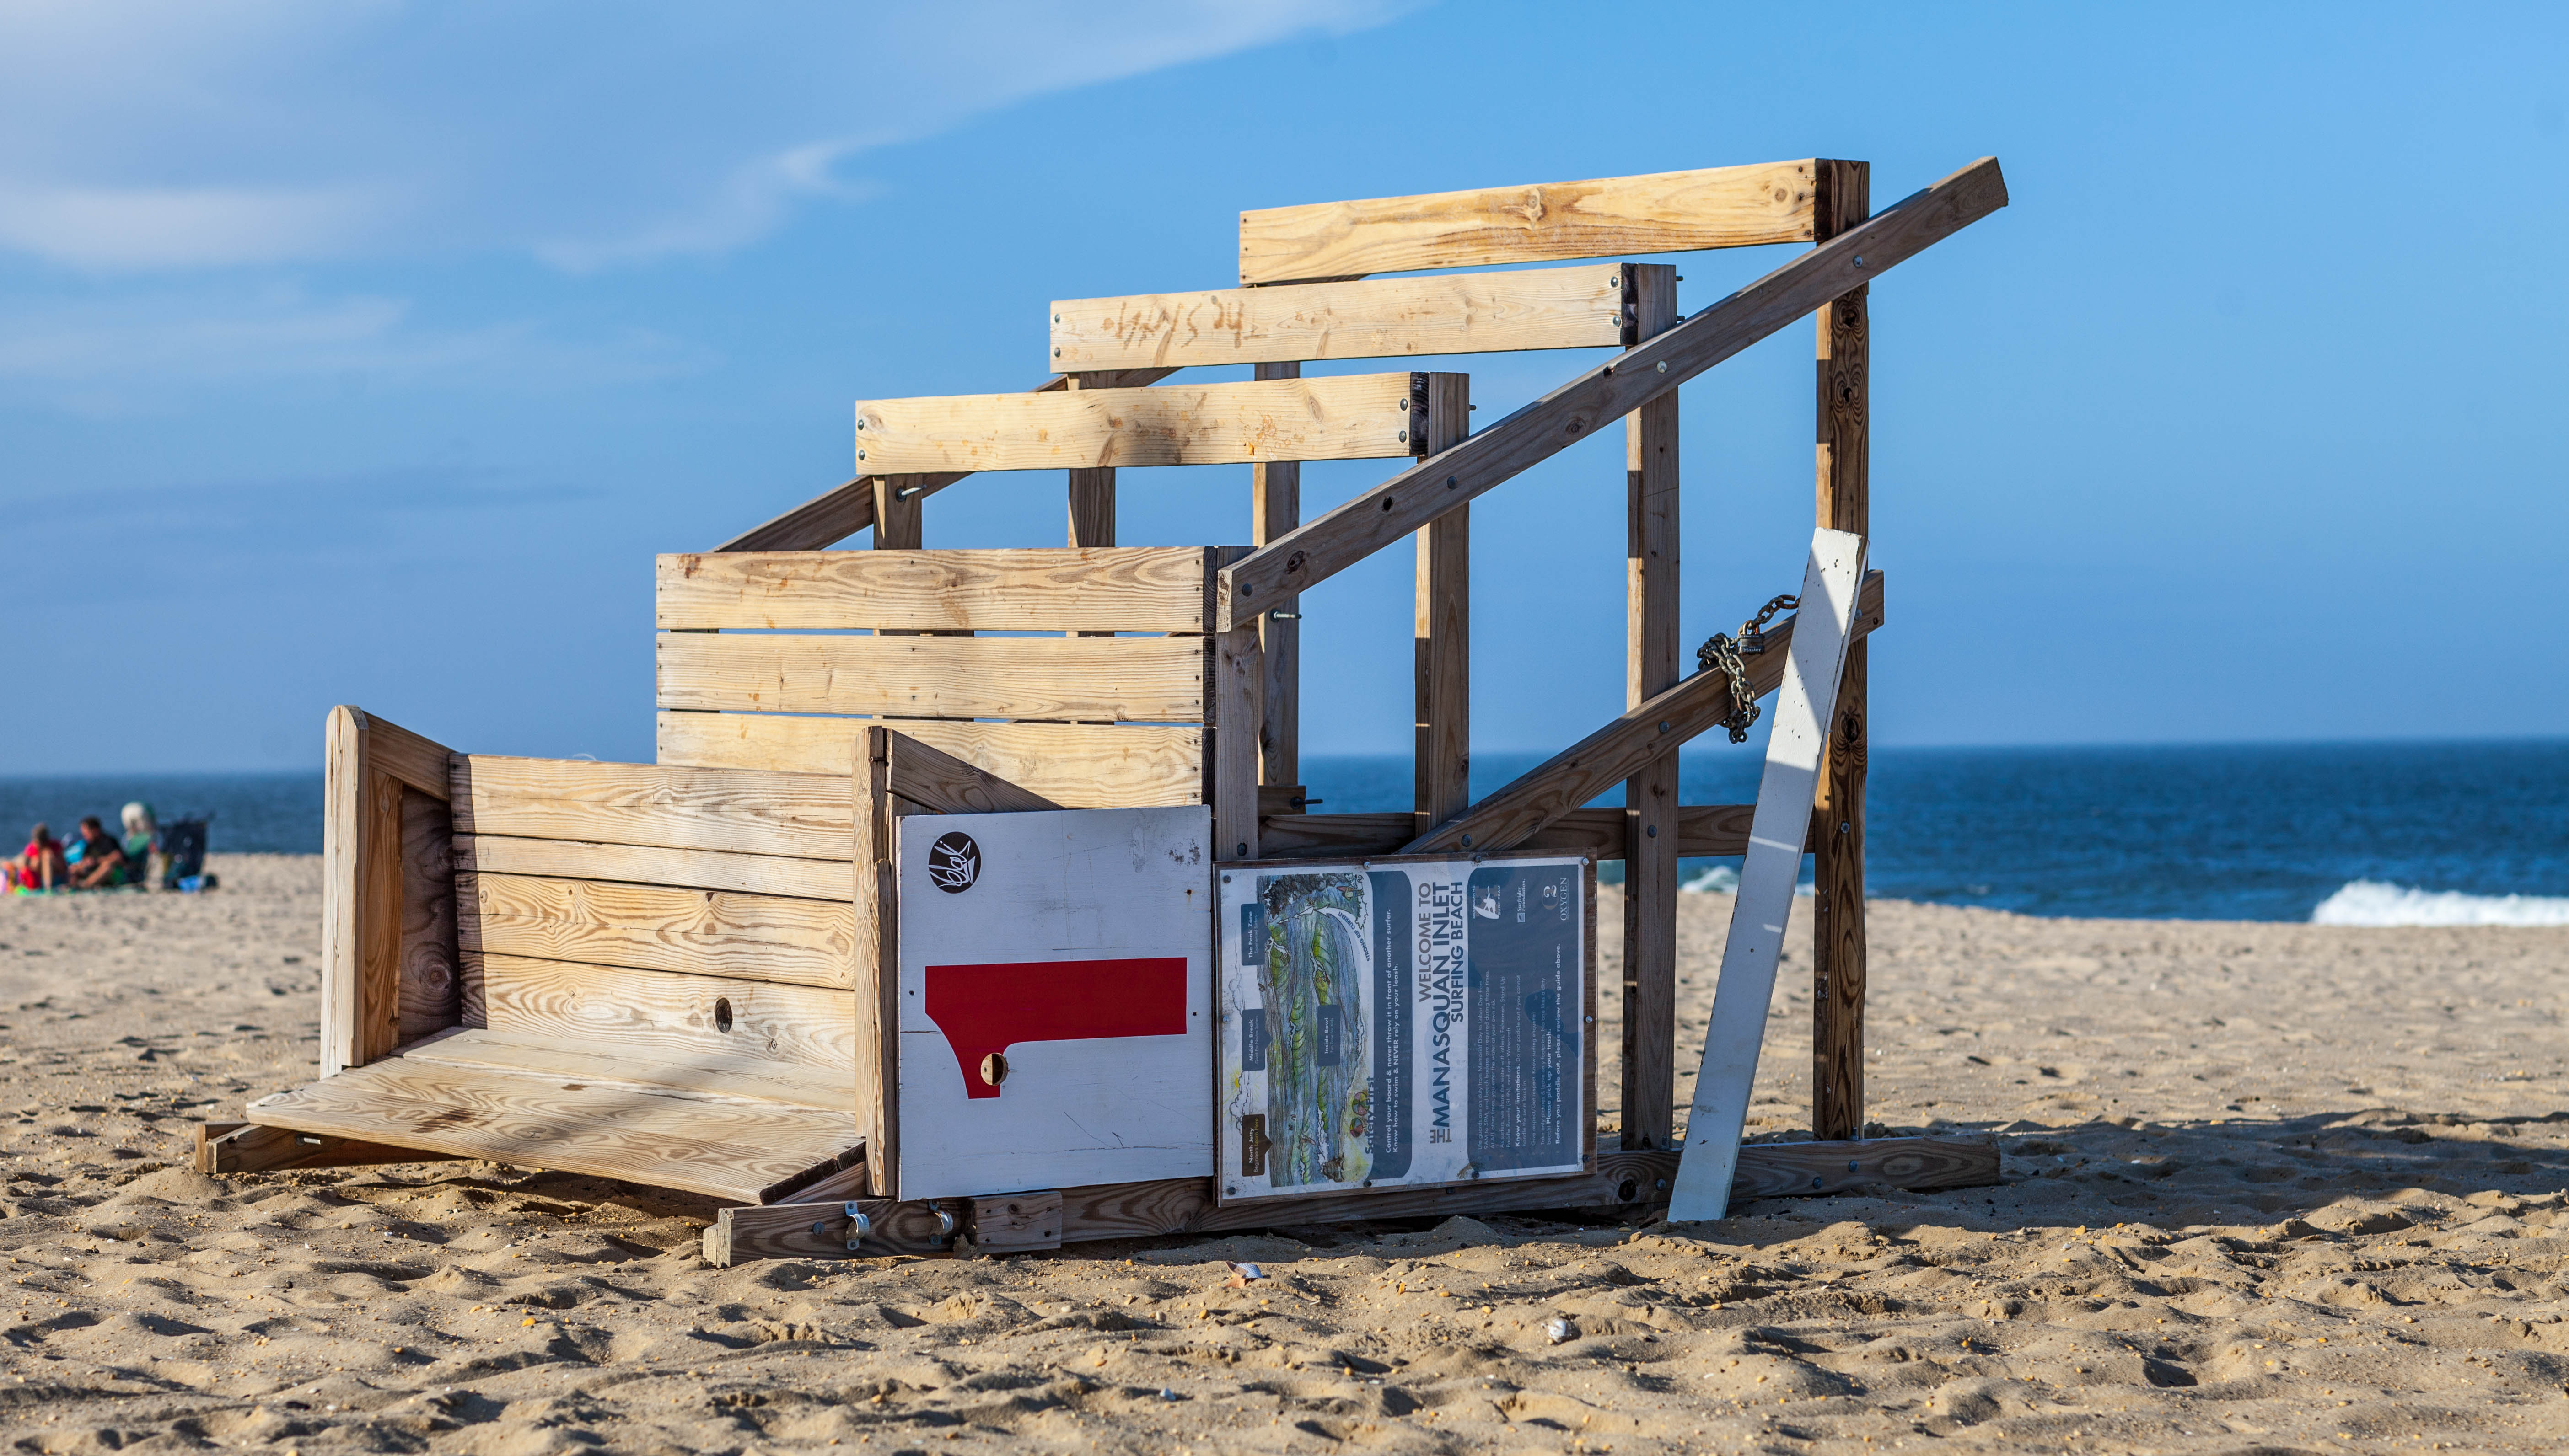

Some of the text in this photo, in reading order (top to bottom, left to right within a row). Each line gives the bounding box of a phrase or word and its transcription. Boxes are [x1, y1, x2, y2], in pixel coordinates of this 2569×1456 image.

[1338, 911, 1355, 930] CURRENT
[1359, 938, 1370, 961] STRONG
[1419, 883, 1431, 1002] WELCOME TO
[1451, 882, 1463, 1022] SURFING BEACH
[1500, 976, 1505, 985] Up
[1433, 882, 1450, 1127] MANASQUAN INLET
[1395, 1010, 1398, 1019] on
[925, 957, 1187, 1099] 1
[1516, 1054, 1520, 1062] Do
[1548, 1071, 1552, 1080] up
[1365, 1076, 1376, 1154] Safety First
[1501, 1111, 1504, 1119] we
[1430, 1129, 1451, 1143] THE
